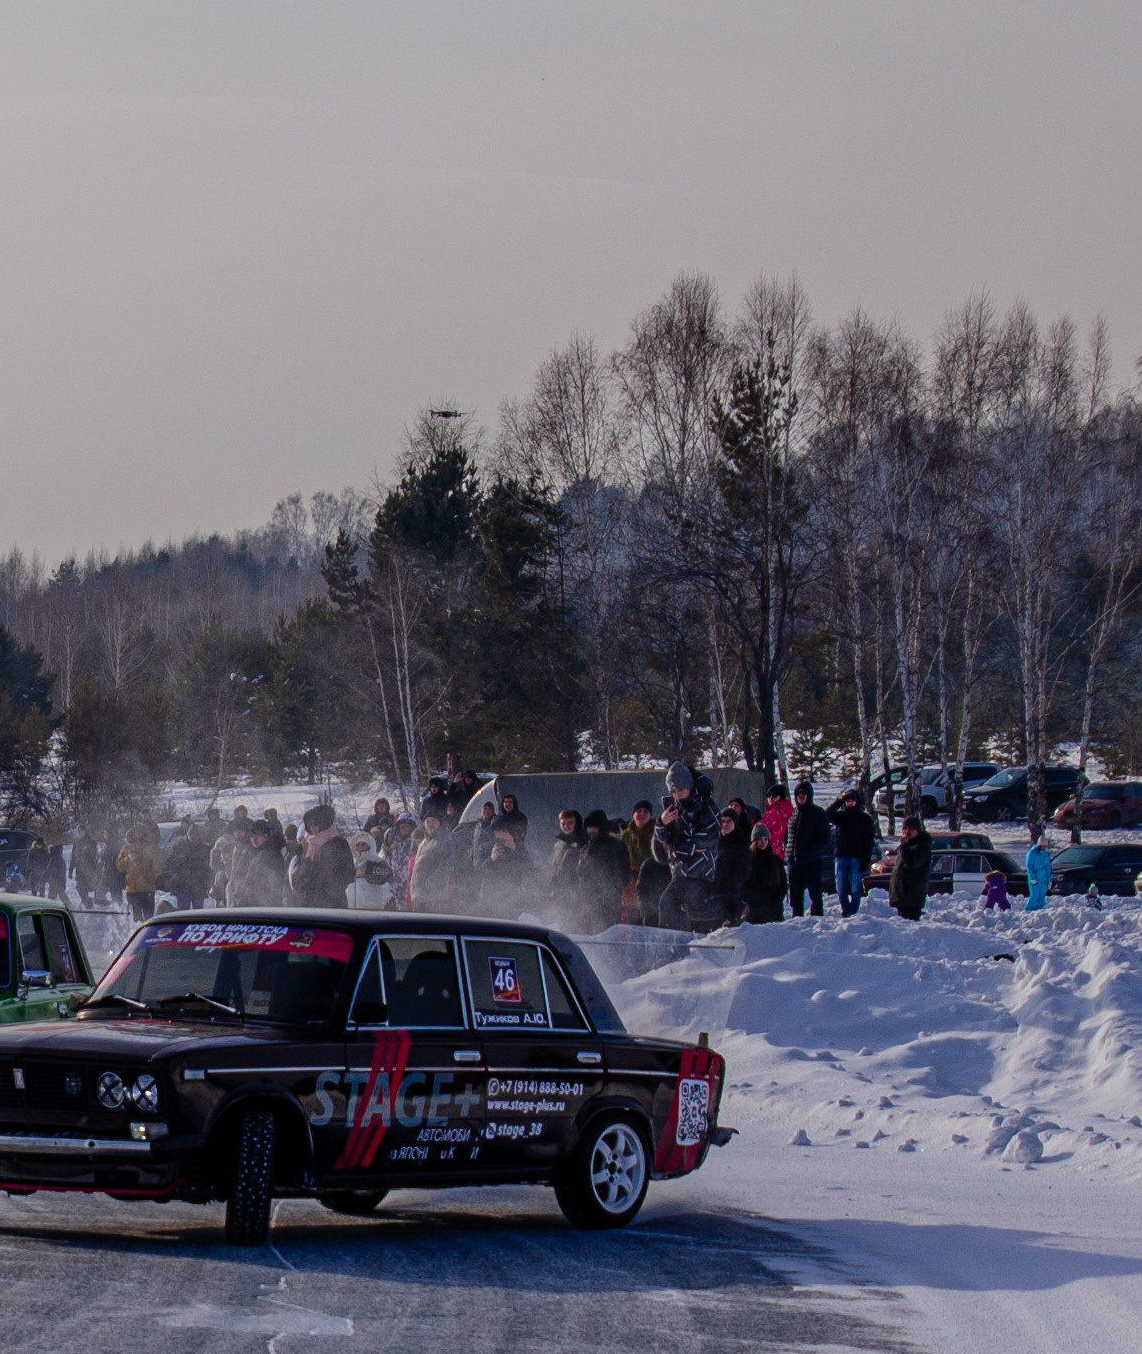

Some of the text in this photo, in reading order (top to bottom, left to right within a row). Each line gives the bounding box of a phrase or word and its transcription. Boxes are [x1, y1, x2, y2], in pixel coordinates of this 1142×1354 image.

[184, 923, 289, 935] КУБОК ИРКУТСКА
[176, 932, 203, 943] ПО
[202, 932, 285, 946] ДРИФТУ
[494, 968, 515, 991] 46
[500, 1080, 584, 1095] +7 (914) 888-50-01
[310, 1071, 480, 1128] STAGE+
[487, 1098, 566, 1114] www.stage-plus.ru
[497, 1122, 543, 1140] stage_38
